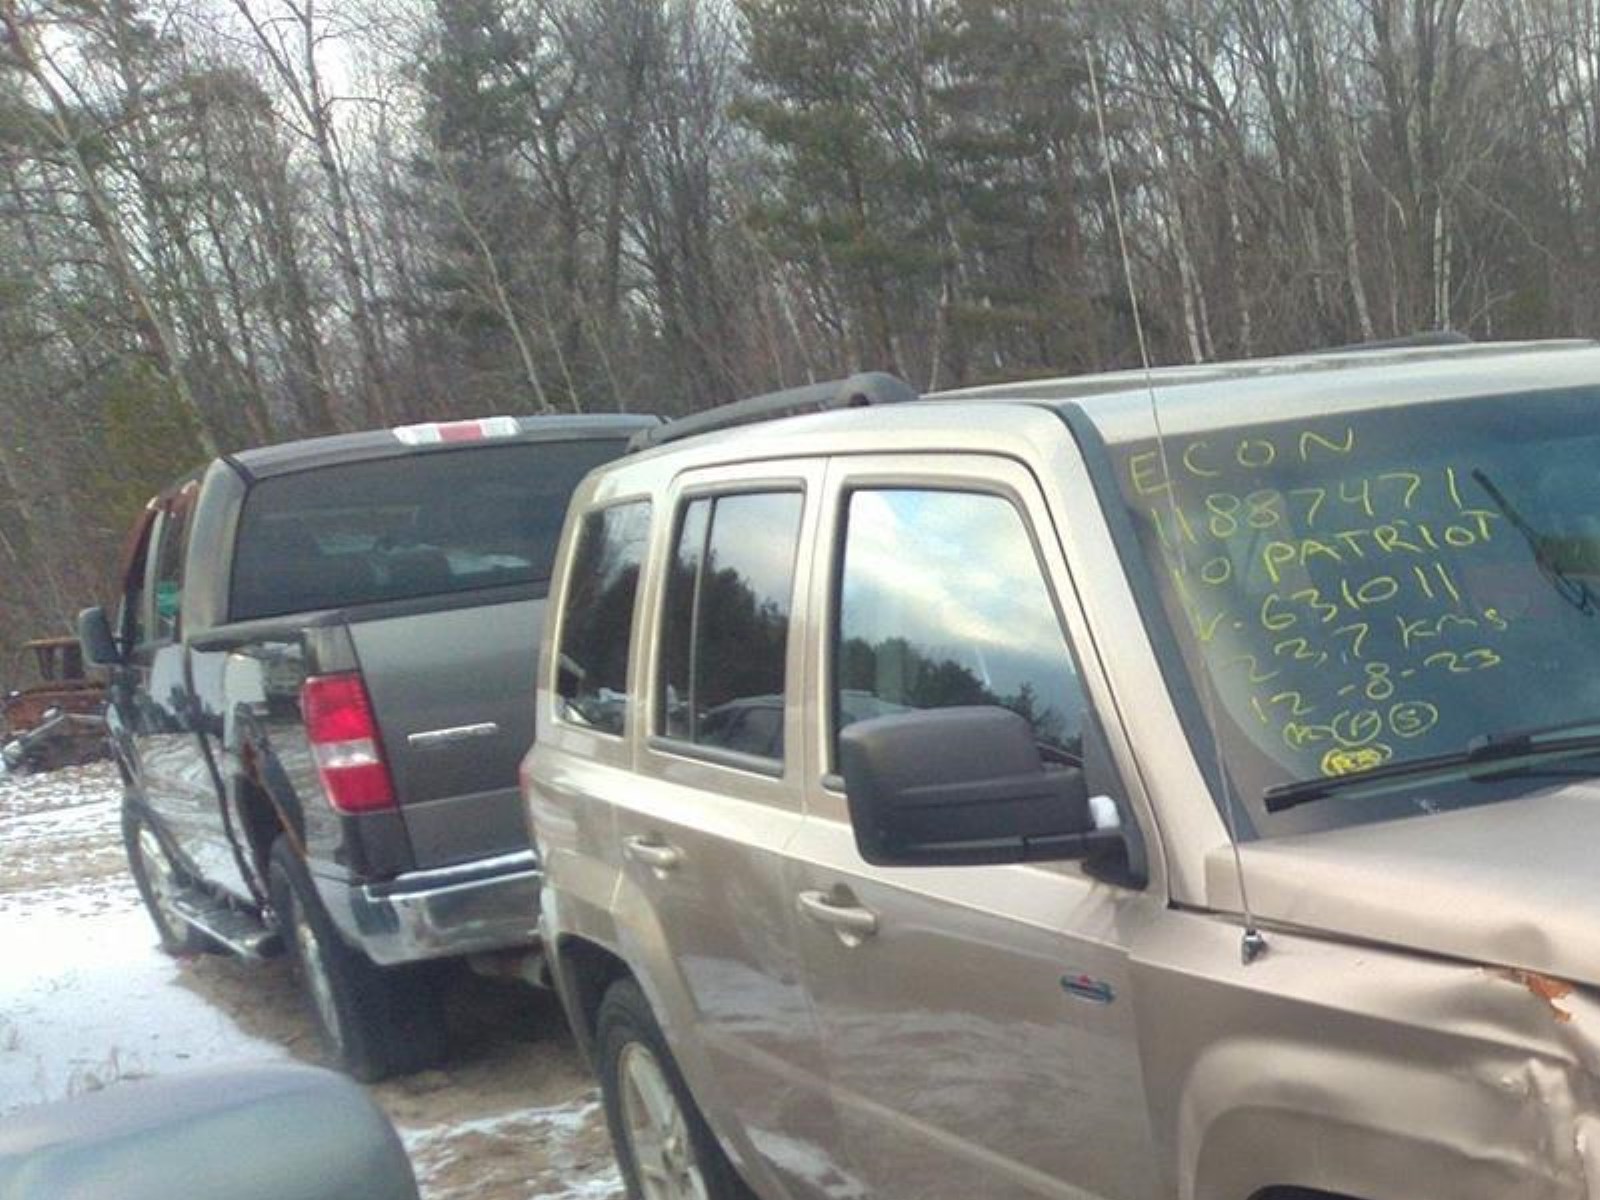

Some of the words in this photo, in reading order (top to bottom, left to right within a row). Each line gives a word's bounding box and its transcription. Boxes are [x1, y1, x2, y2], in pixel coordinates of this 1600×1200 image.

[1129, 426, 1354, 495] ECON
[1151, 466, 1463, 546] 11887471
[1263, 509, 1499, 582] PATRIOT
